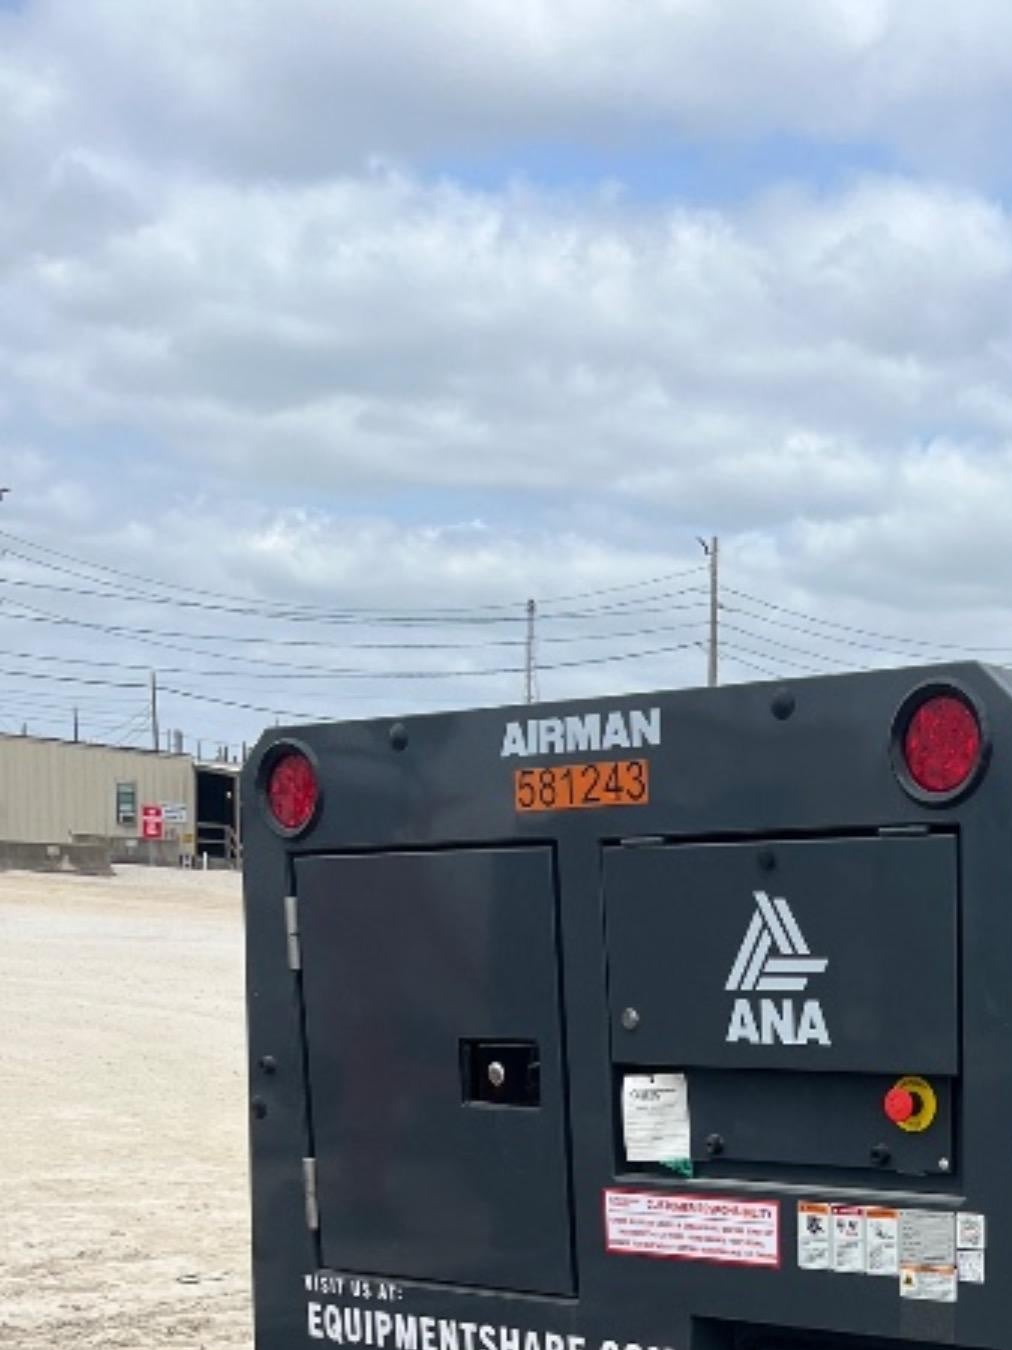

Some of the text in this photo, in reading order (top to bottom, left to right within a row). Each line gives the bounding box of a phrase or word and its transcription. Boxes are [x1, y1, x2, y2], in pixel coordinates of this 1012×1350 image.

[501, 707, 661, 757] AIRMAN
[518, 761, 646, 808] 581243
[725, 998, 832, 1046] ANA
[304, 1274, 403, 1302] VISIT US AT:
